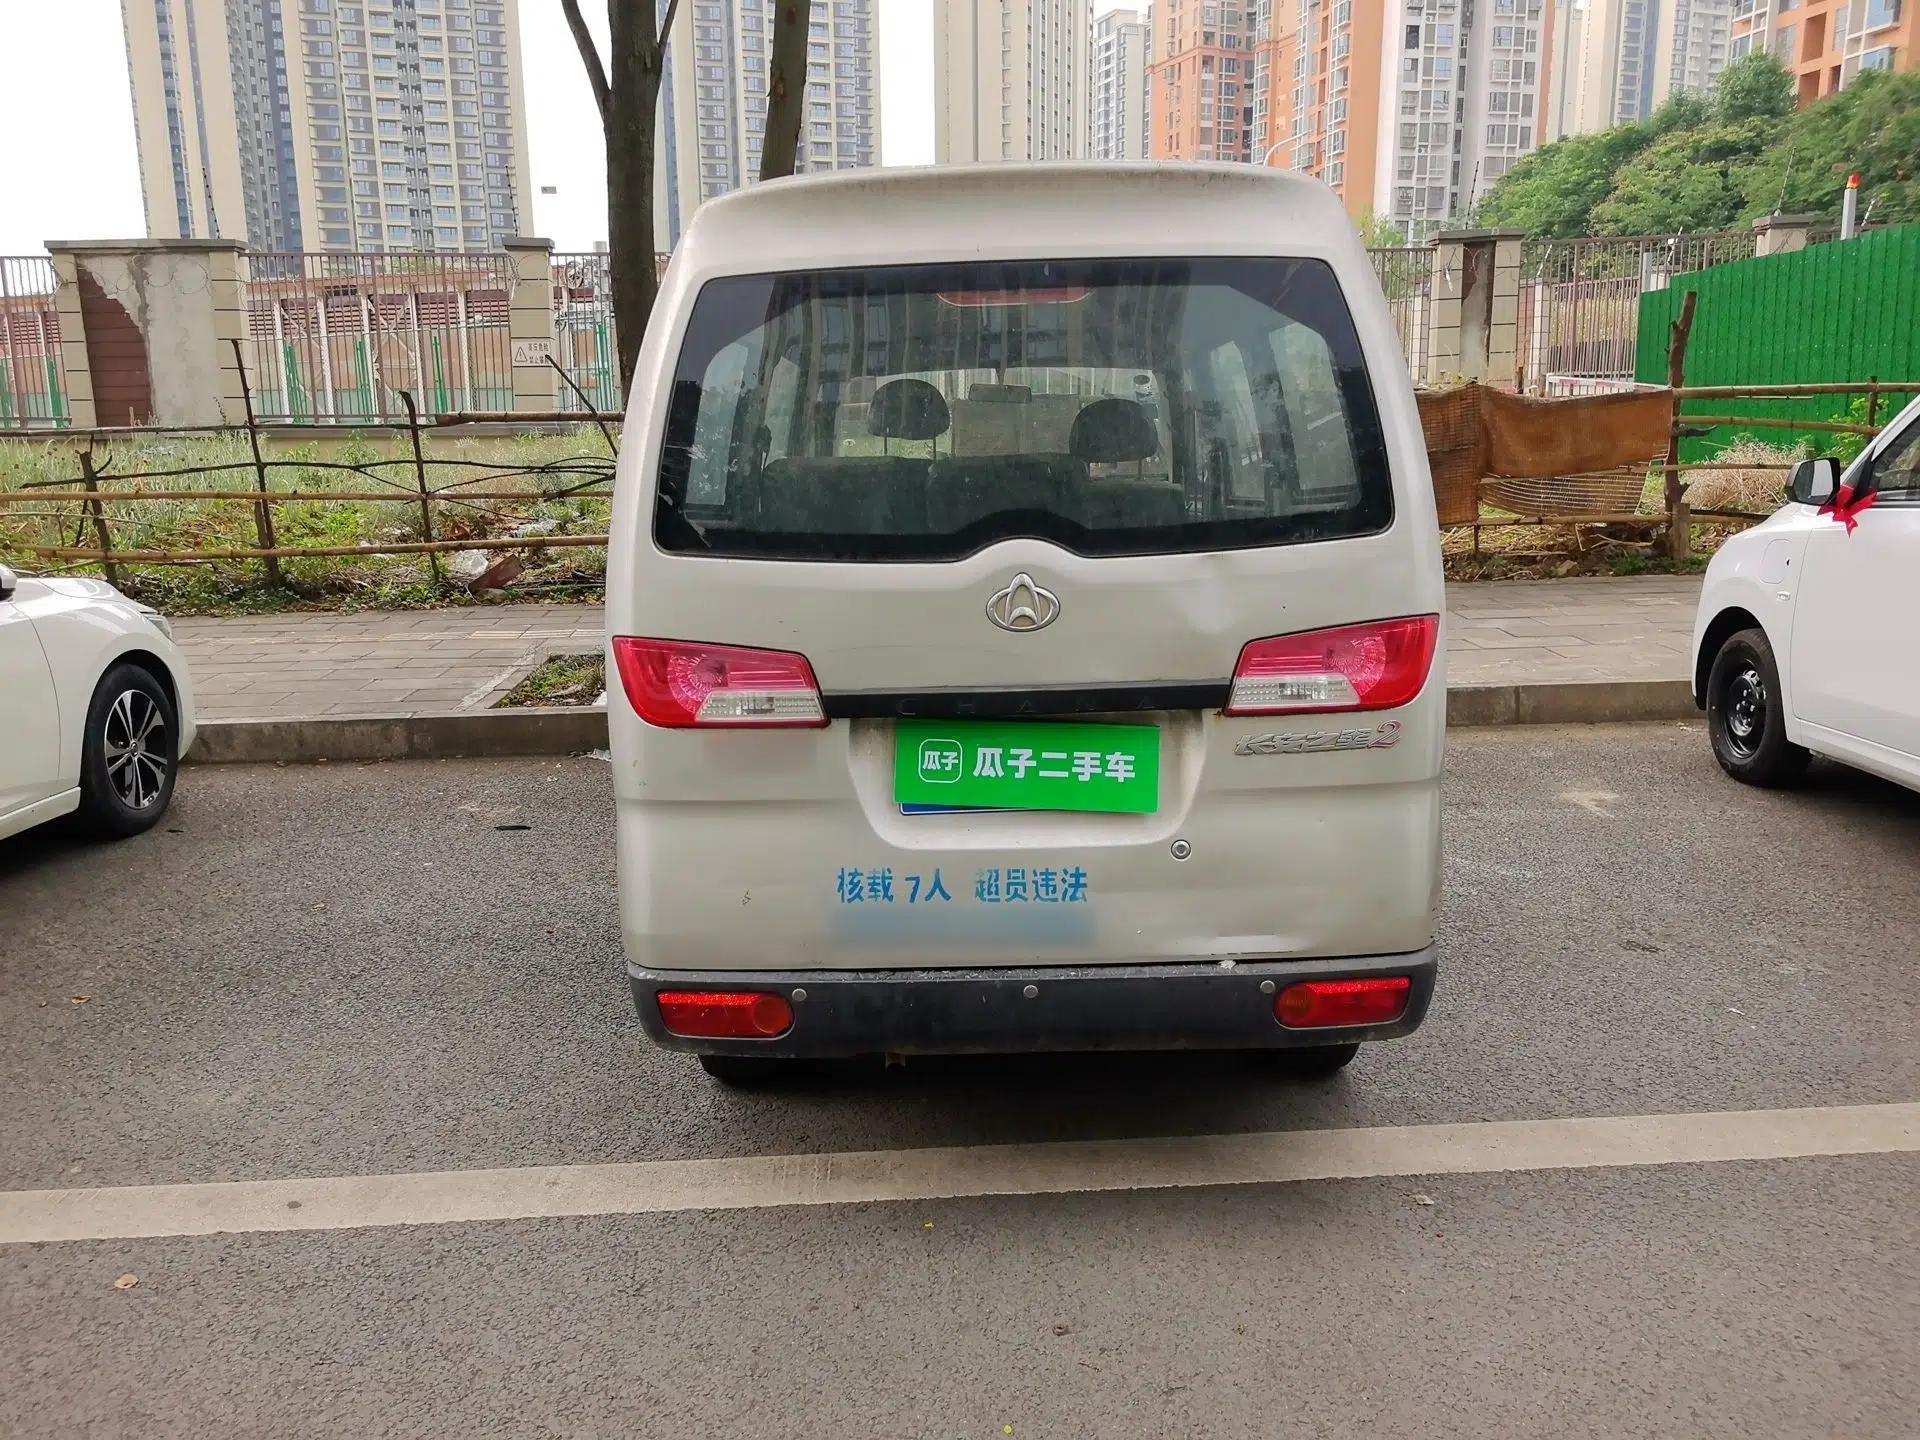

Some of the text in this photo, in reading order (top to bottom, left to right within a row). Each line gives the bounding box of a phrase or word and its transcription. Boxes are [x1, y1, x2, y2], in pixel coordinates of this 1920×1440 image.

[922, 747, 1136, 783] 瓜子 瓜子二手车
[975, 866, 1089, 903] 超员违法
